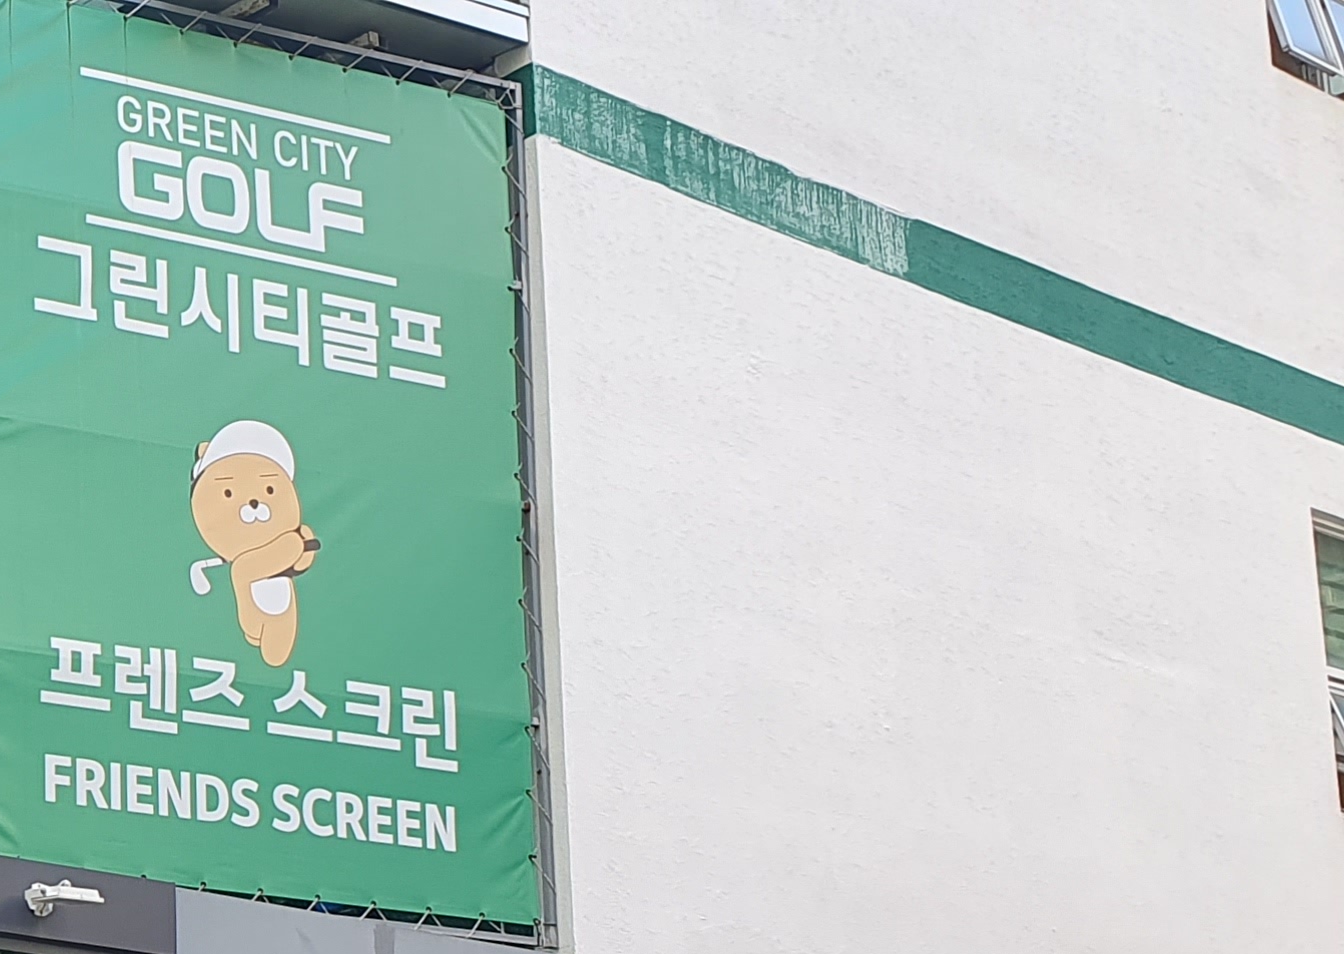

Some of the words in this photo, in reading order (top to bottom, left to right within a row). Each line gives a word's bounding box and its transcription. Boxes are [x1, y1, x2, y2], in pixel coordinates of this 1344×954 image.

[116, 95, 258, 160] GREEN
[273, 130, 359, 181] CITY
[116, 140, 365, 253] GOLF
[33, 234, 447, 389] 그린시티골프
[40, 636, 251, 735] 프렌즈
[266, 670, 459, 773] 스크린
[43, 753, 261, 829] FRIENDS
[271, 783, 457, 853] SCREEN
